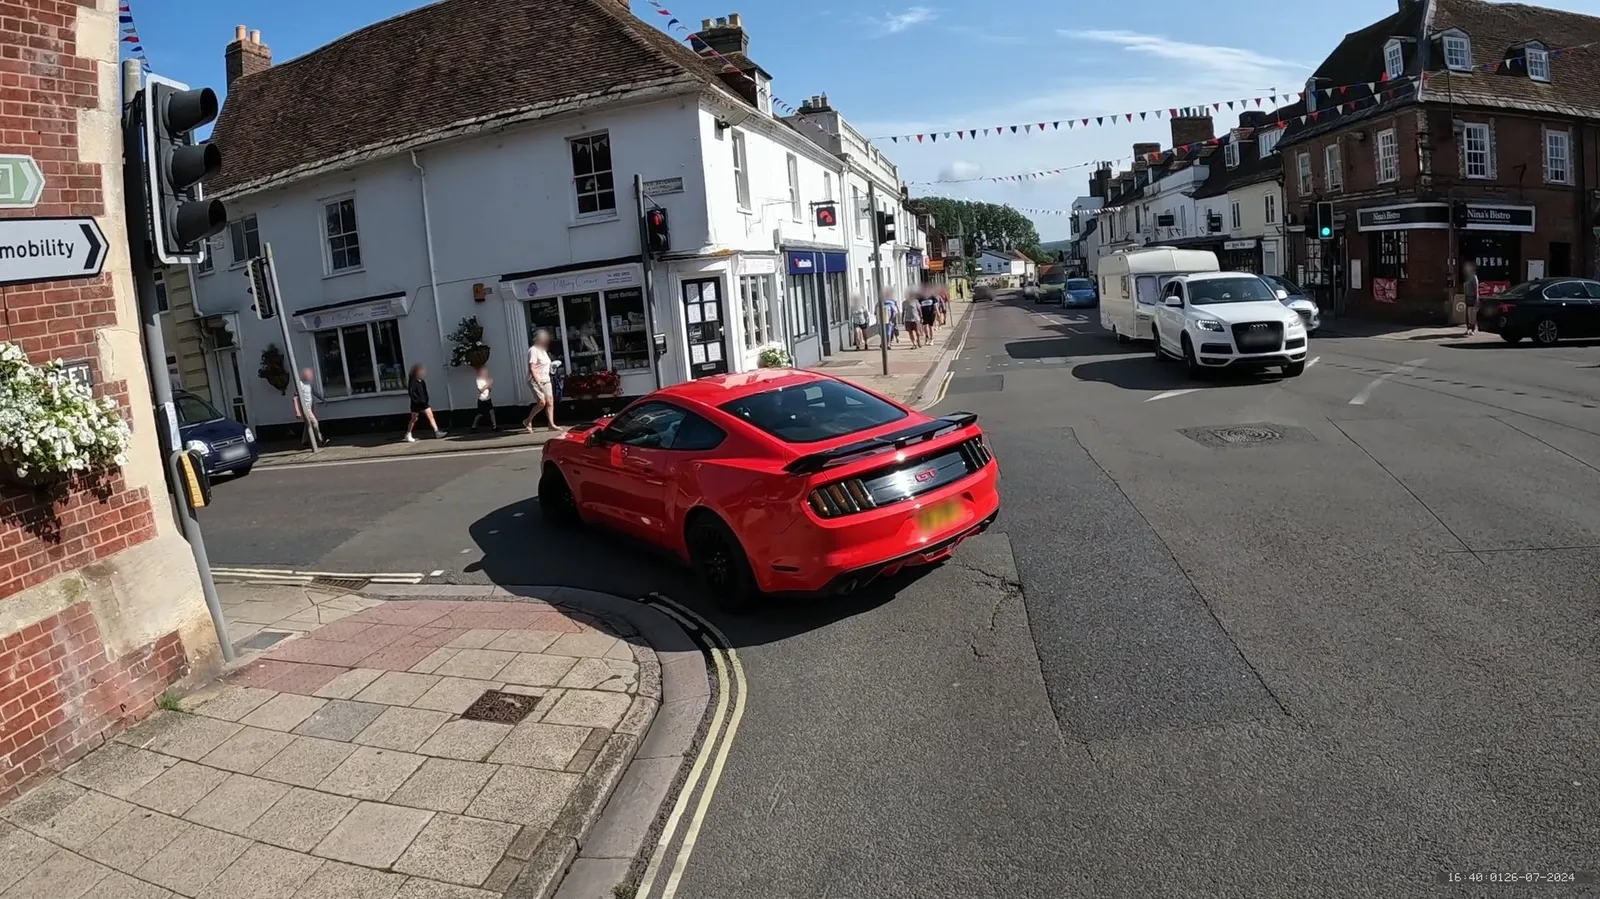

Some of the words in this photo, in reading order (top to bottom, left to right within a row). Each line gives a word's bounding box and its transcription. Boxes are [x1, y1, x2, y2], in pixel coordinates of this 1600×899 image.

[1467, 209, 1489, 219] Nina's
[1490, 210, 1511, 220] Bistro
[0, 239, 74, 259] mobility
[1475, 256, 1503, 267] OPEN
[915, 467, 936, 482] GT
